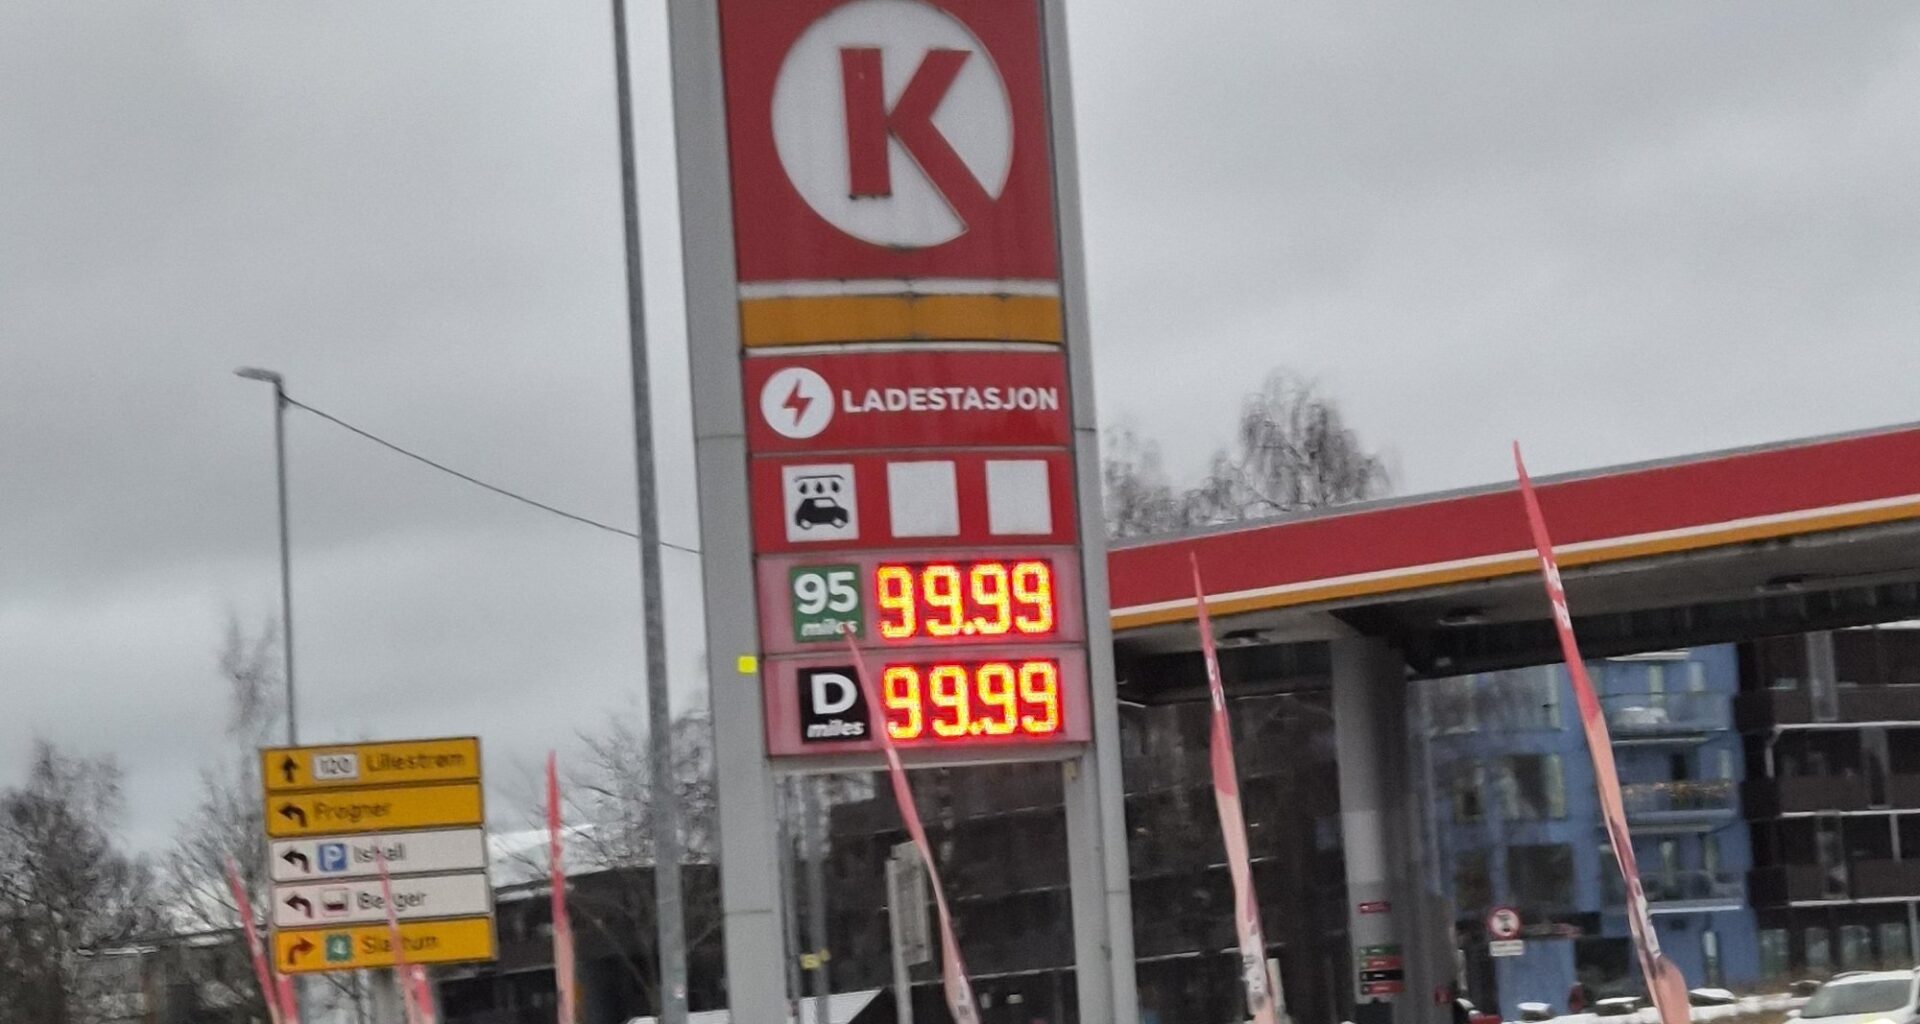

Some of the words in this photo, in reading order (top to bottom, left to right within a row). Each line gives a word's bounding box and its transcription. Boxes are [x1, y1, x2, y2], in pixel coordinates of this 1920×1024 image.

[840, 47, 997, 232] K
[842, 386, 1059, 414] LADESTASJON
[795, 571, 858, 615] 95
[876, 563, 1053, 638] 99.99
[810, 673, 858, 715] D
[883, 662, 1059, 739] 99.99
[807, 719, 864, 738] miles
[366, 752, 465, 772] Lillestrøm
[313, 801, 392, 823] Frogner
[357, 891, 426, 911] Beger
